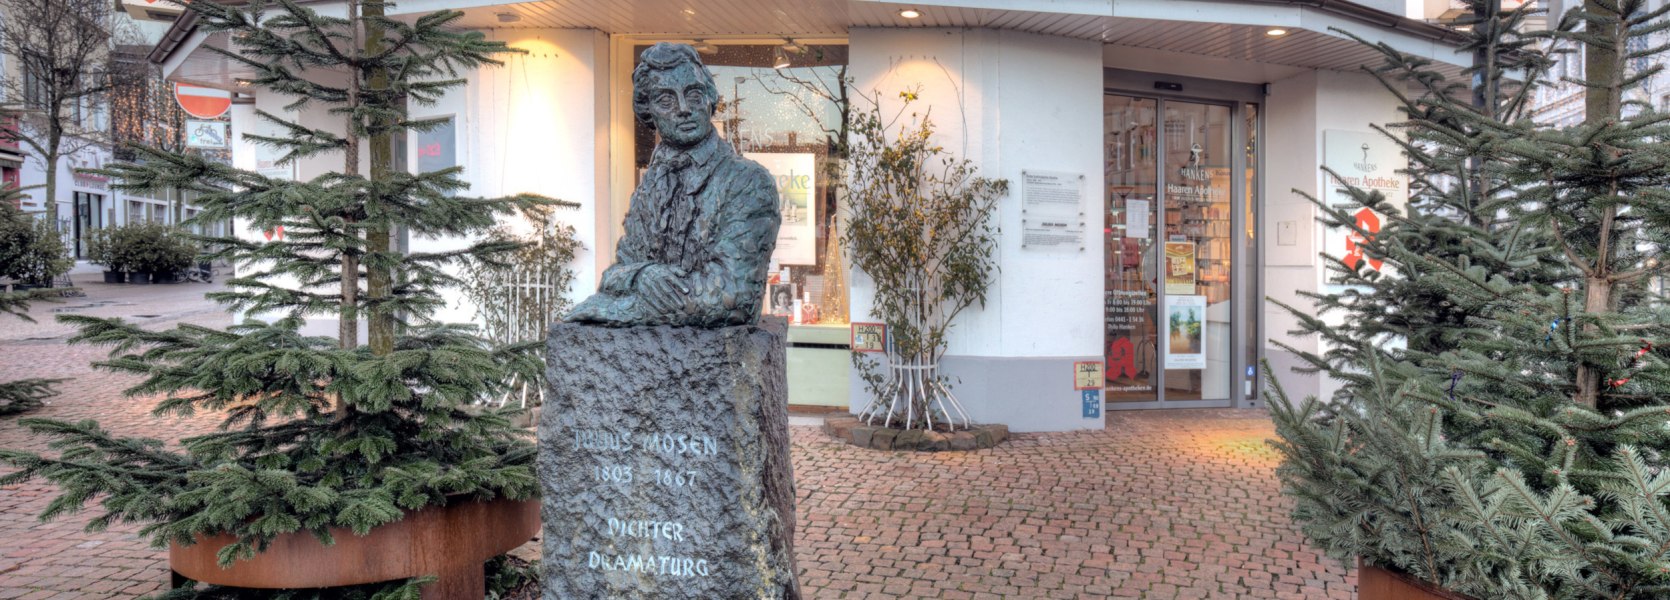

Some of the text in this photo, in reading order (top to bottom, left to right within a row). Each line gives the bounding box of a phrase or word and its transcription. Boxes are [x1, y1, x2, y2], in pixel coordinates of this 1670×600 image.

[1180, 168, 1214, 181] HANKENS
[1353, 161, 1378, 172] HANKENS
[777, 169, 811, 190] eke
[1168, 184, 1192, 194] Haaren
[1362, 175, 1400, 189] Apotheke
[572, 429, 718, 455] JULIUS MOSEN
[593, 465, 697, 487] 1803 1867
[607, 516, 684, 542] DICHTER
[588, 550, 709, 577] DRAMATURG
